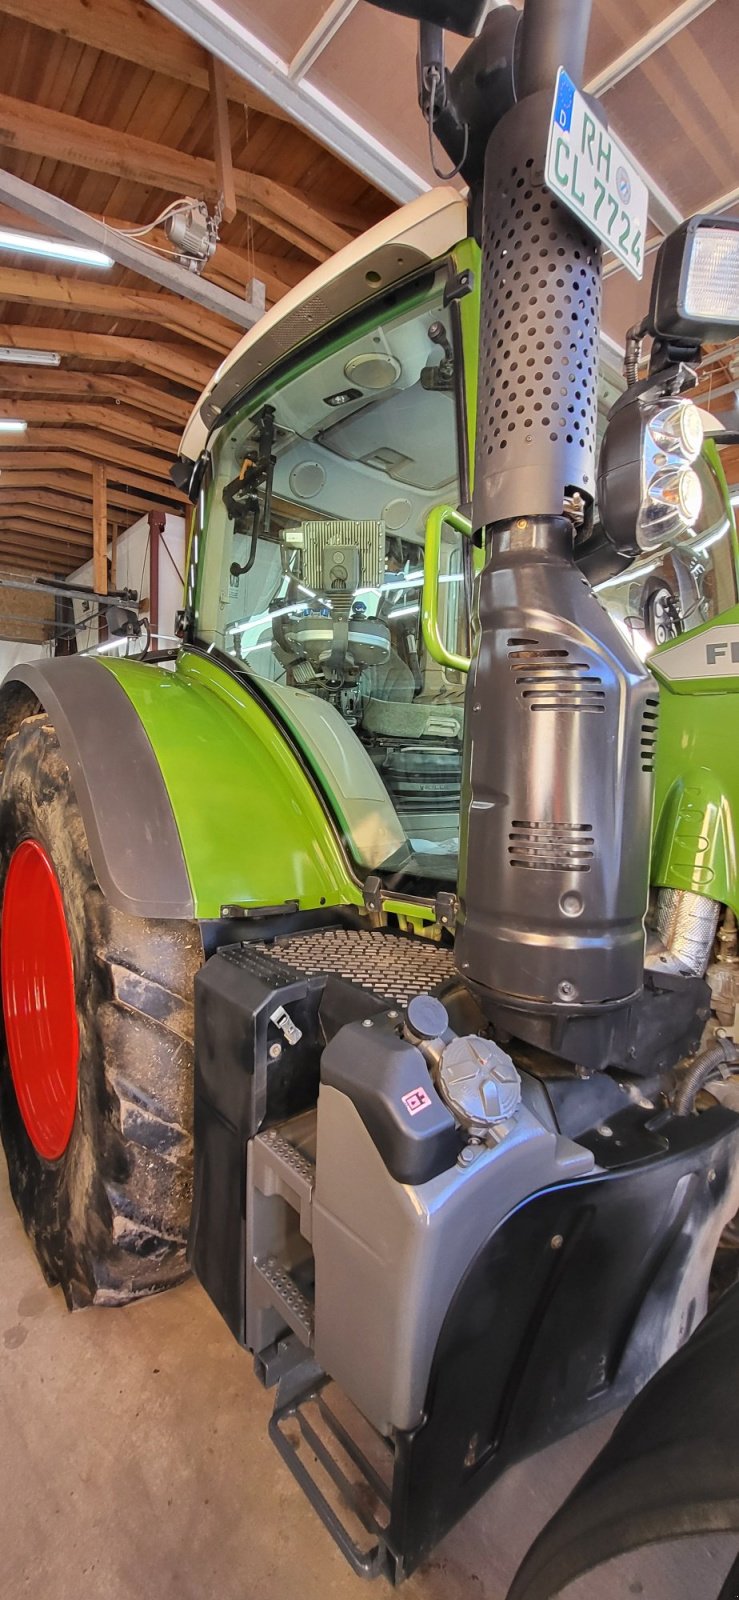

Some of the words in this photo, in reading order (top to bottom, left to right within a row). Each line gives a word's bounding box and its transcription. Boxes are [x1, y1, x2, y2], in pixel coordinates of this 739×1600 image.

[560, 109, 567, 127] D
[582, 112, 611, 182] RH
[555, 137, 585, 206] CL
[594, 176, 641, 267] 7724
